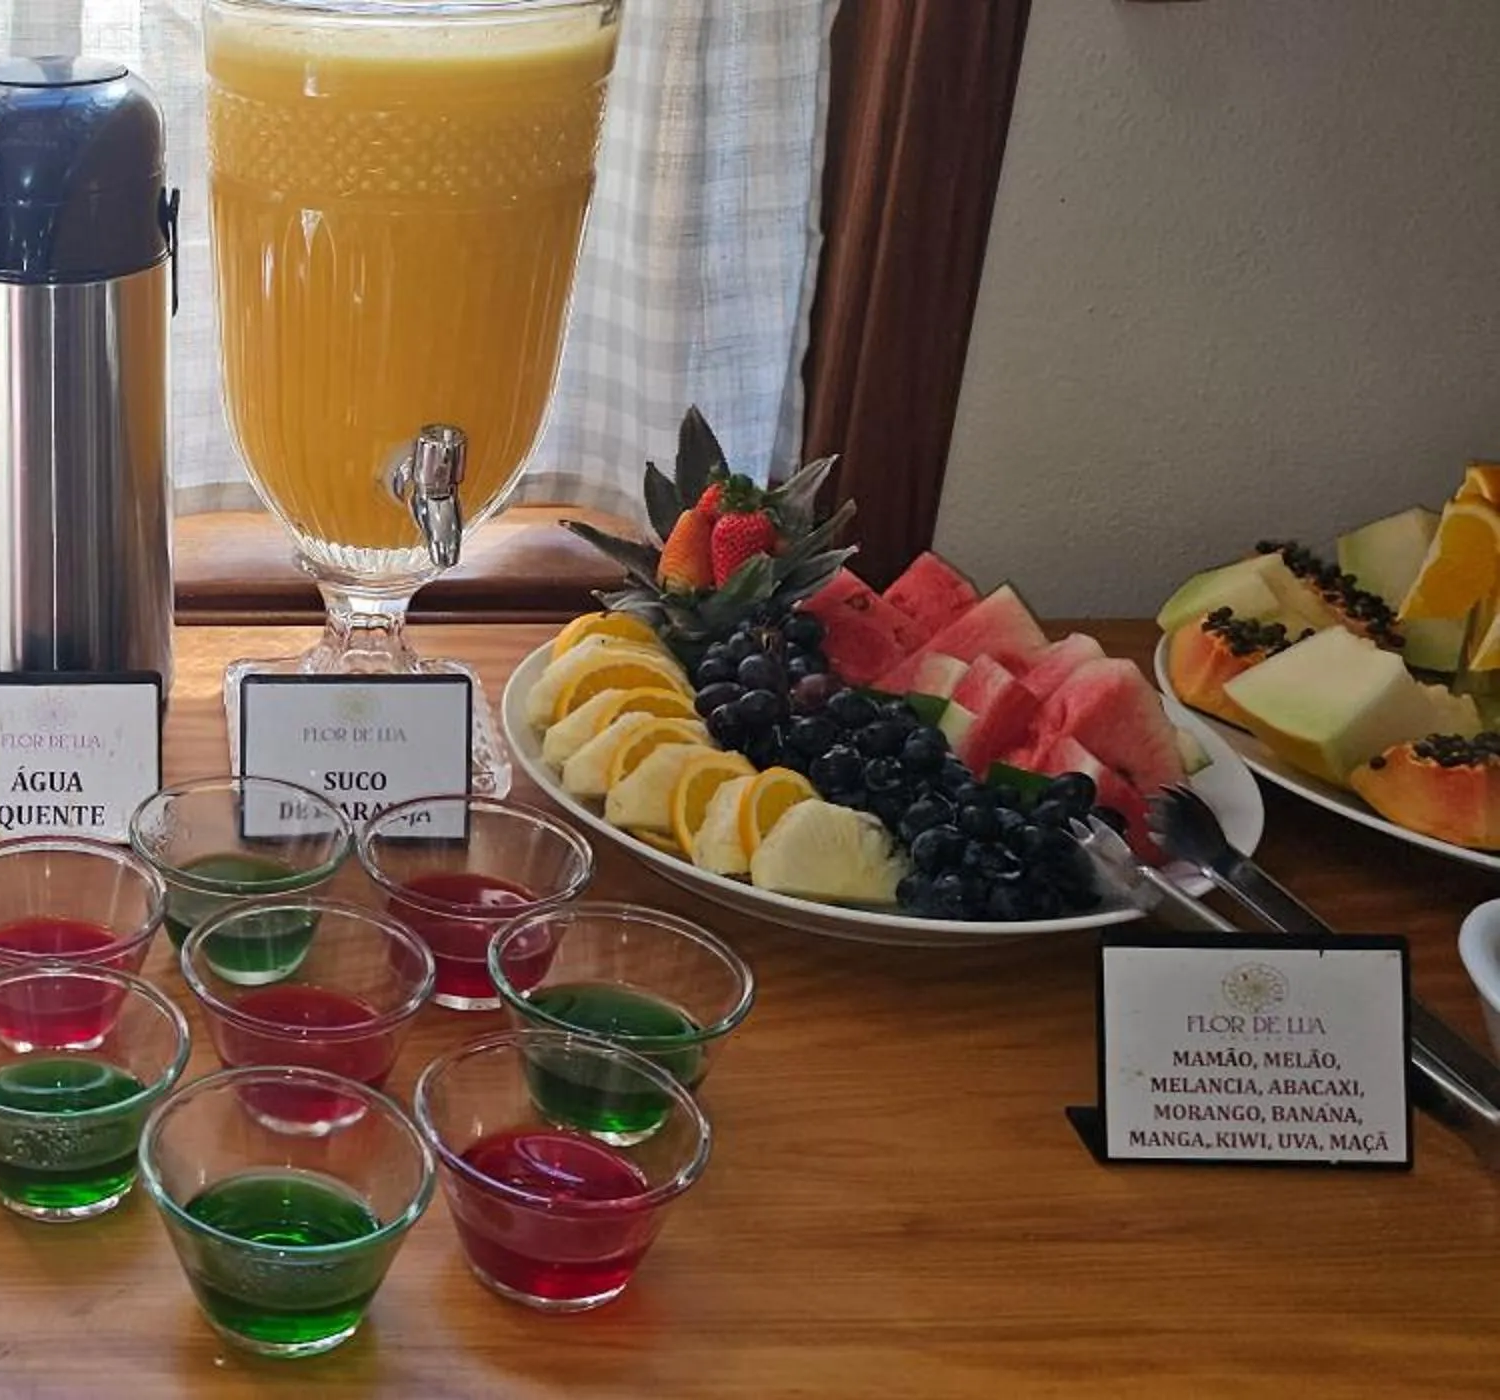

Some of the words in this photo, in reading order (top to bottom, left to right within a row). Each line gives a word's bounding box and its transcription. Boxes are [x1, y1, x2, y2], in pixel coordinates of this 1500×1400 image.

[11, 766, 83, 793] ÁGUA
[323, 771, 387, 791] SUCO
[1187, 1014, 1246, 1034] FLOR
[1253, 1015, 1281, 1035] DE
[1287, 1016, 1327, 1036] LUA
[1172, 1047, 1258, 1071] MAMÃO,
[1263, 1048, 1341, 1071] MELÃO,
[1150, 1077, 1263, 1097] MELANCIA,
[1267, 1079, 1365, 1098] ABACAXI,
[1153, 1103, 1266, 1124] MORANGO,
[1128, 1130, 1212, 1149] MANGA,
[1215, 1131, 1272, 1150] KIWI,
[1277, 1132, 1324, 1151] UVA,
[1329, 1131, 1389, 1155] MAÇÃ
